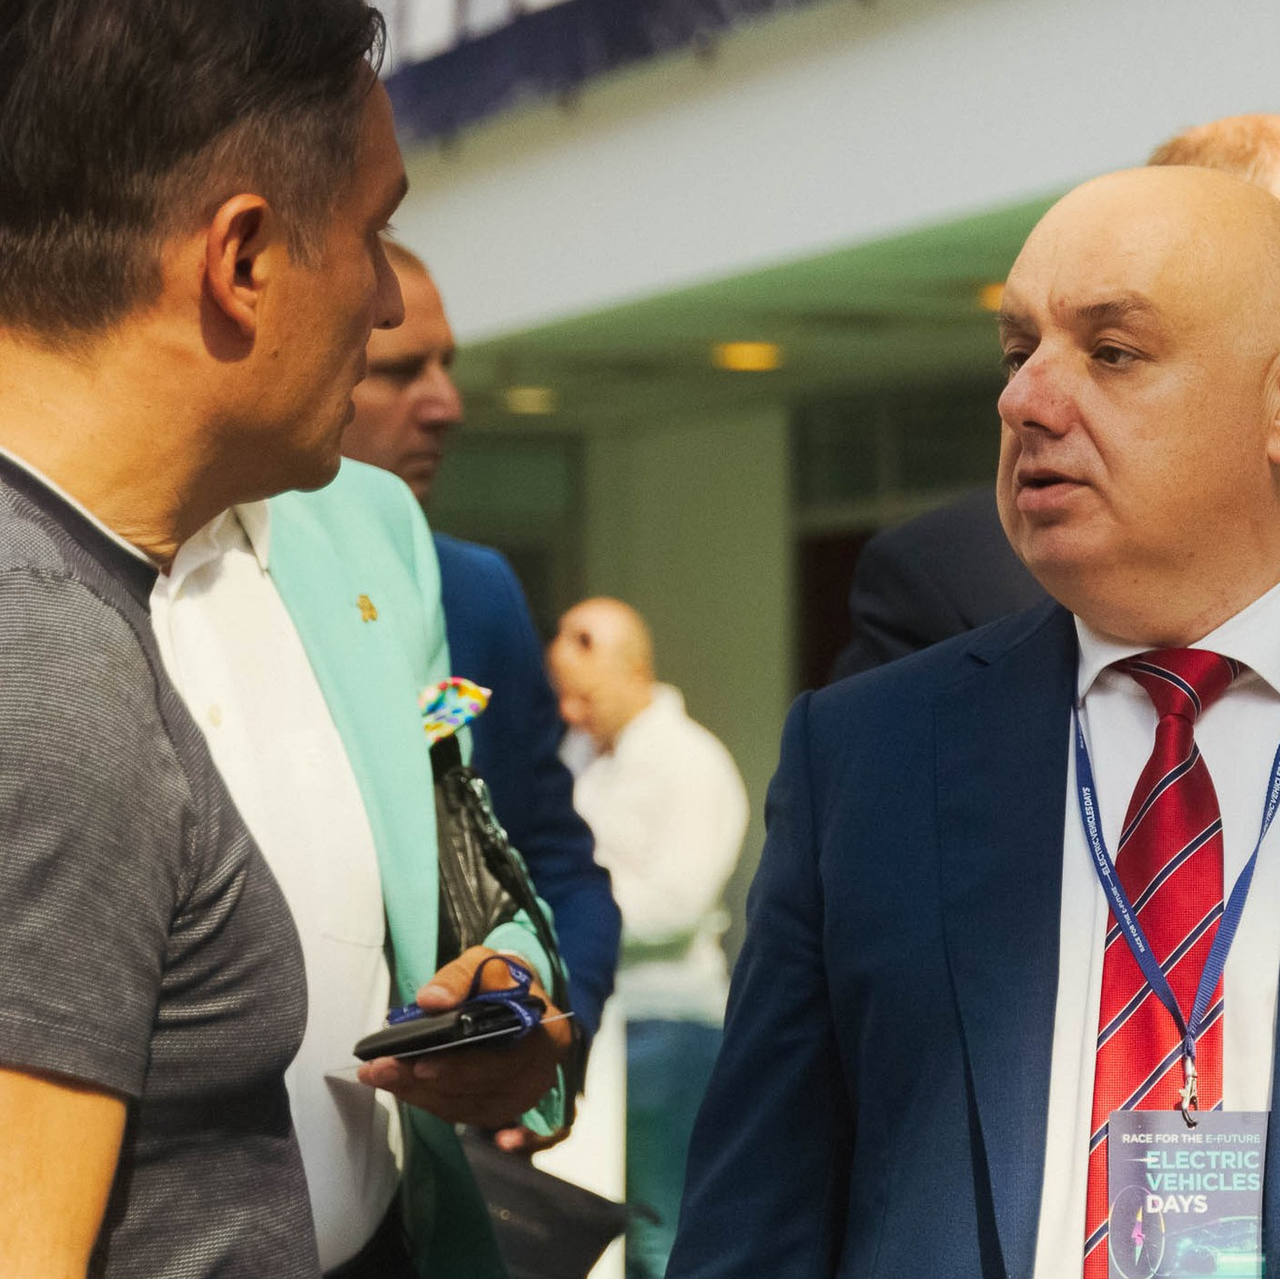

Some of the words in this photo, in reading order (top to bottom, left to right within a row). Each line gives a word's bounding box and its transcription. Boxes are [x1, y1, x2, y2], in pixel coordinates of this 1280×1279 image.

[1082, 786, 1093, 806] DAYS
[1085, 806, 1098, 840] VEHICLES
[1092, 837, 1111, 876] ELECTRIC
[1111, 886, 1128, 914] E-FUTURE
[1123, 912, 1133, 926] THE
[1129, 924, 1138, 937] FOR
[1135, 935, 1146, 953] RACE
[1122, 1133, 1152, 1144] RACE
[1155, 1133, 1179, 1144] FOR
[1181, 1134, 1203, 1144] THE
[1205, 1134, 1261, 1144] E-FUTURE
[1146, 1150, 1260, 1170] ELECTRIC
[1146, 1173, 1261, 1192] VEHICLES
[1146, 1194, 1208, 1214] DAYS
